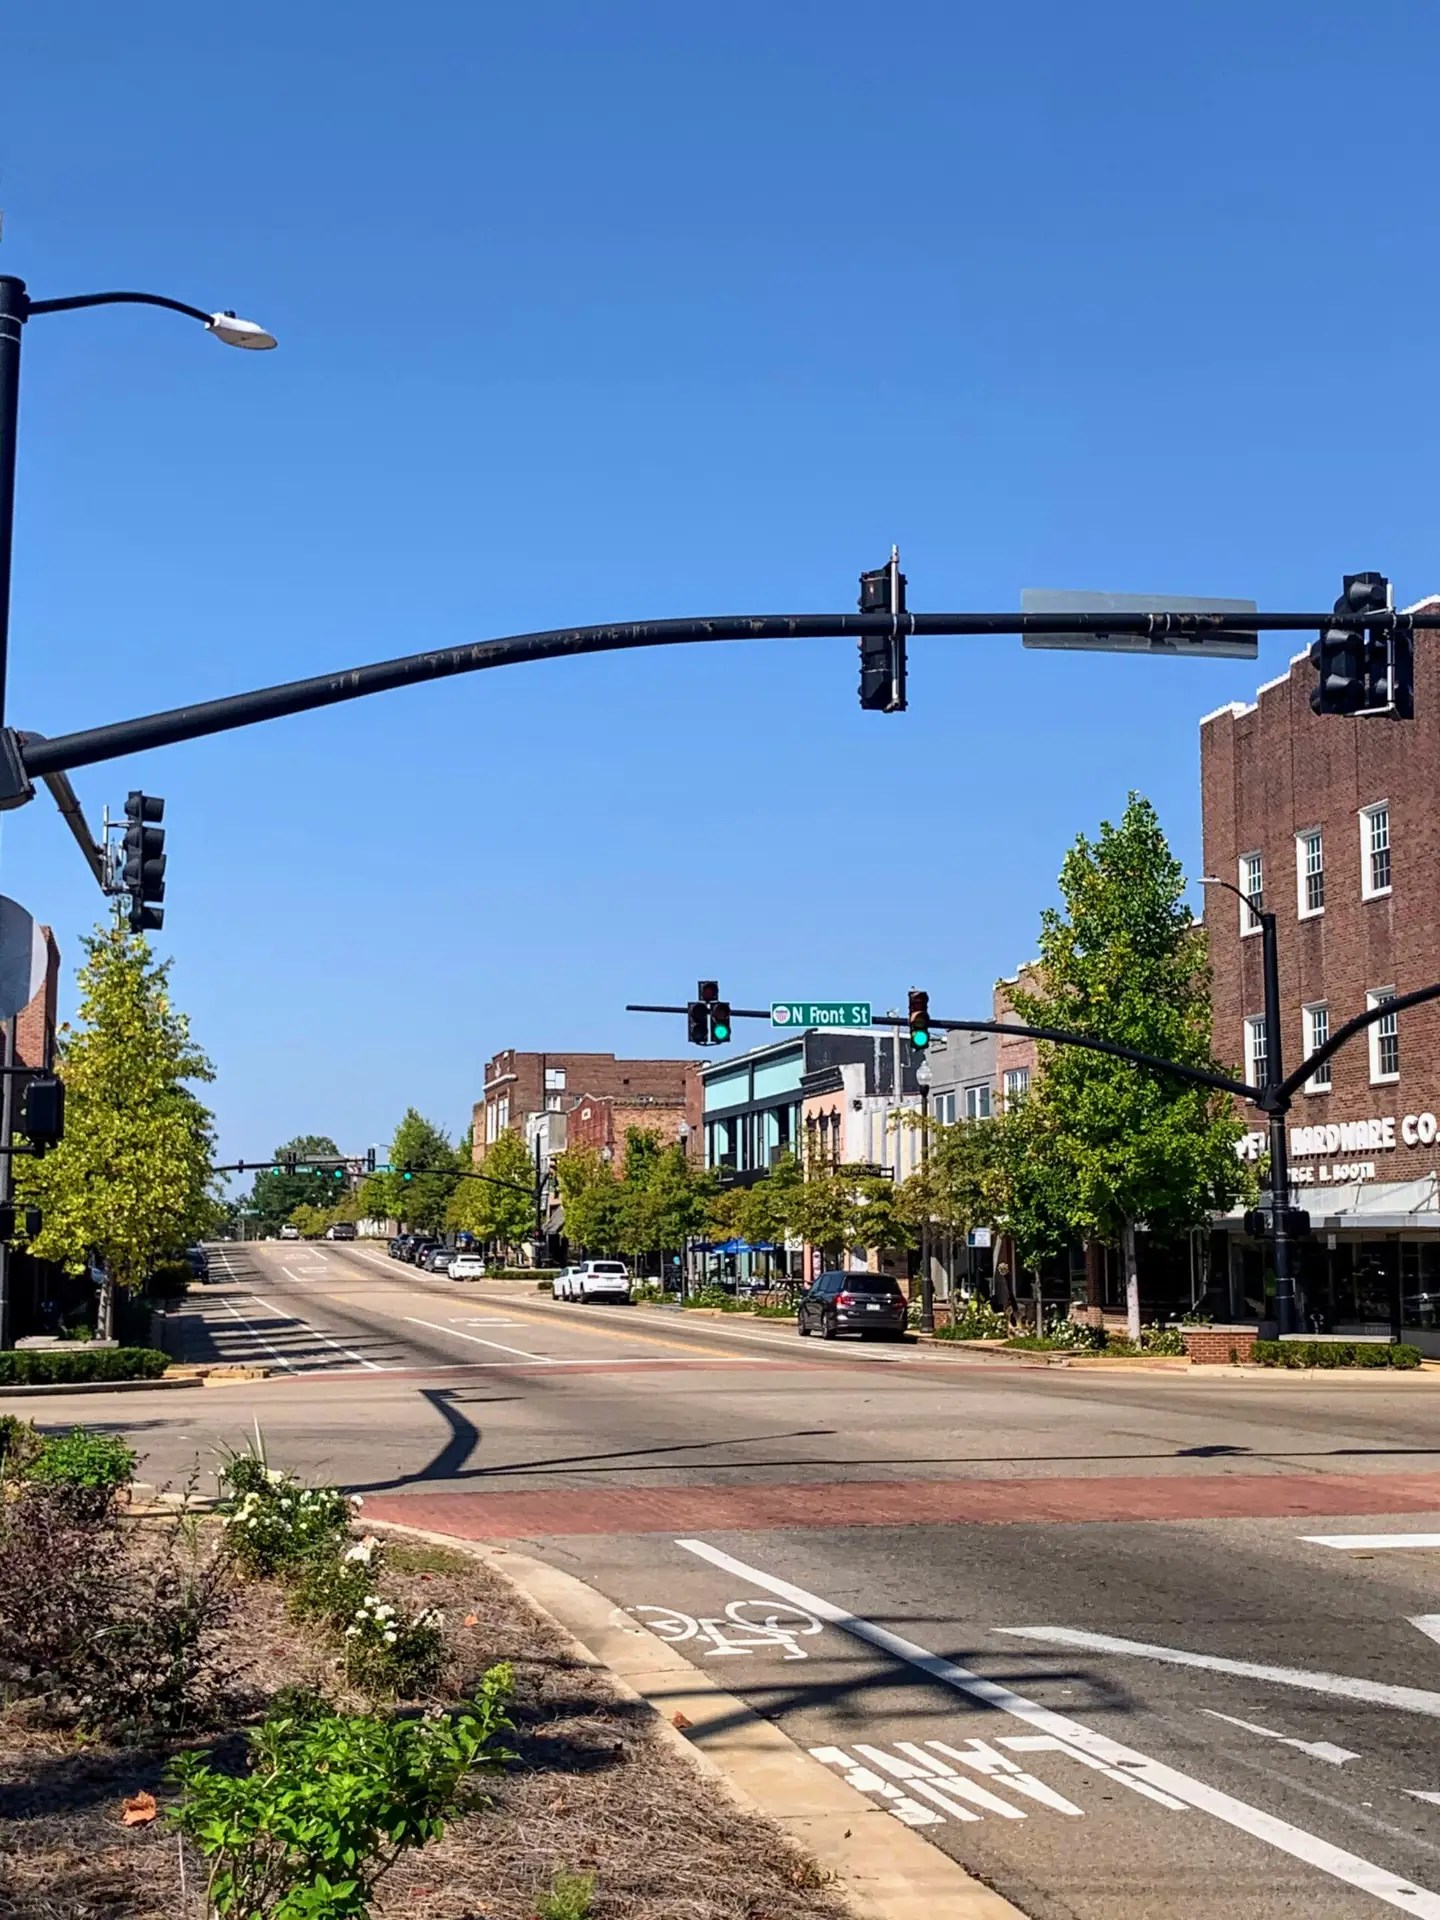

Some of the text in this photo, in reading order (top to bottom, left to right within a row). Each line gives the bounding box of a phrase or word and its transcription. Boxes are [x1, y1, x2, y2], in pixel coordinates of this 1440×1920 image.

[793, 1006, 868, 1024] N Front St
[1290, 1117, 1397, 1156] HARDWARE
[1333, 1161, 1376, 1180] BOOTH
[788, 1239, 800, 1249] 30
